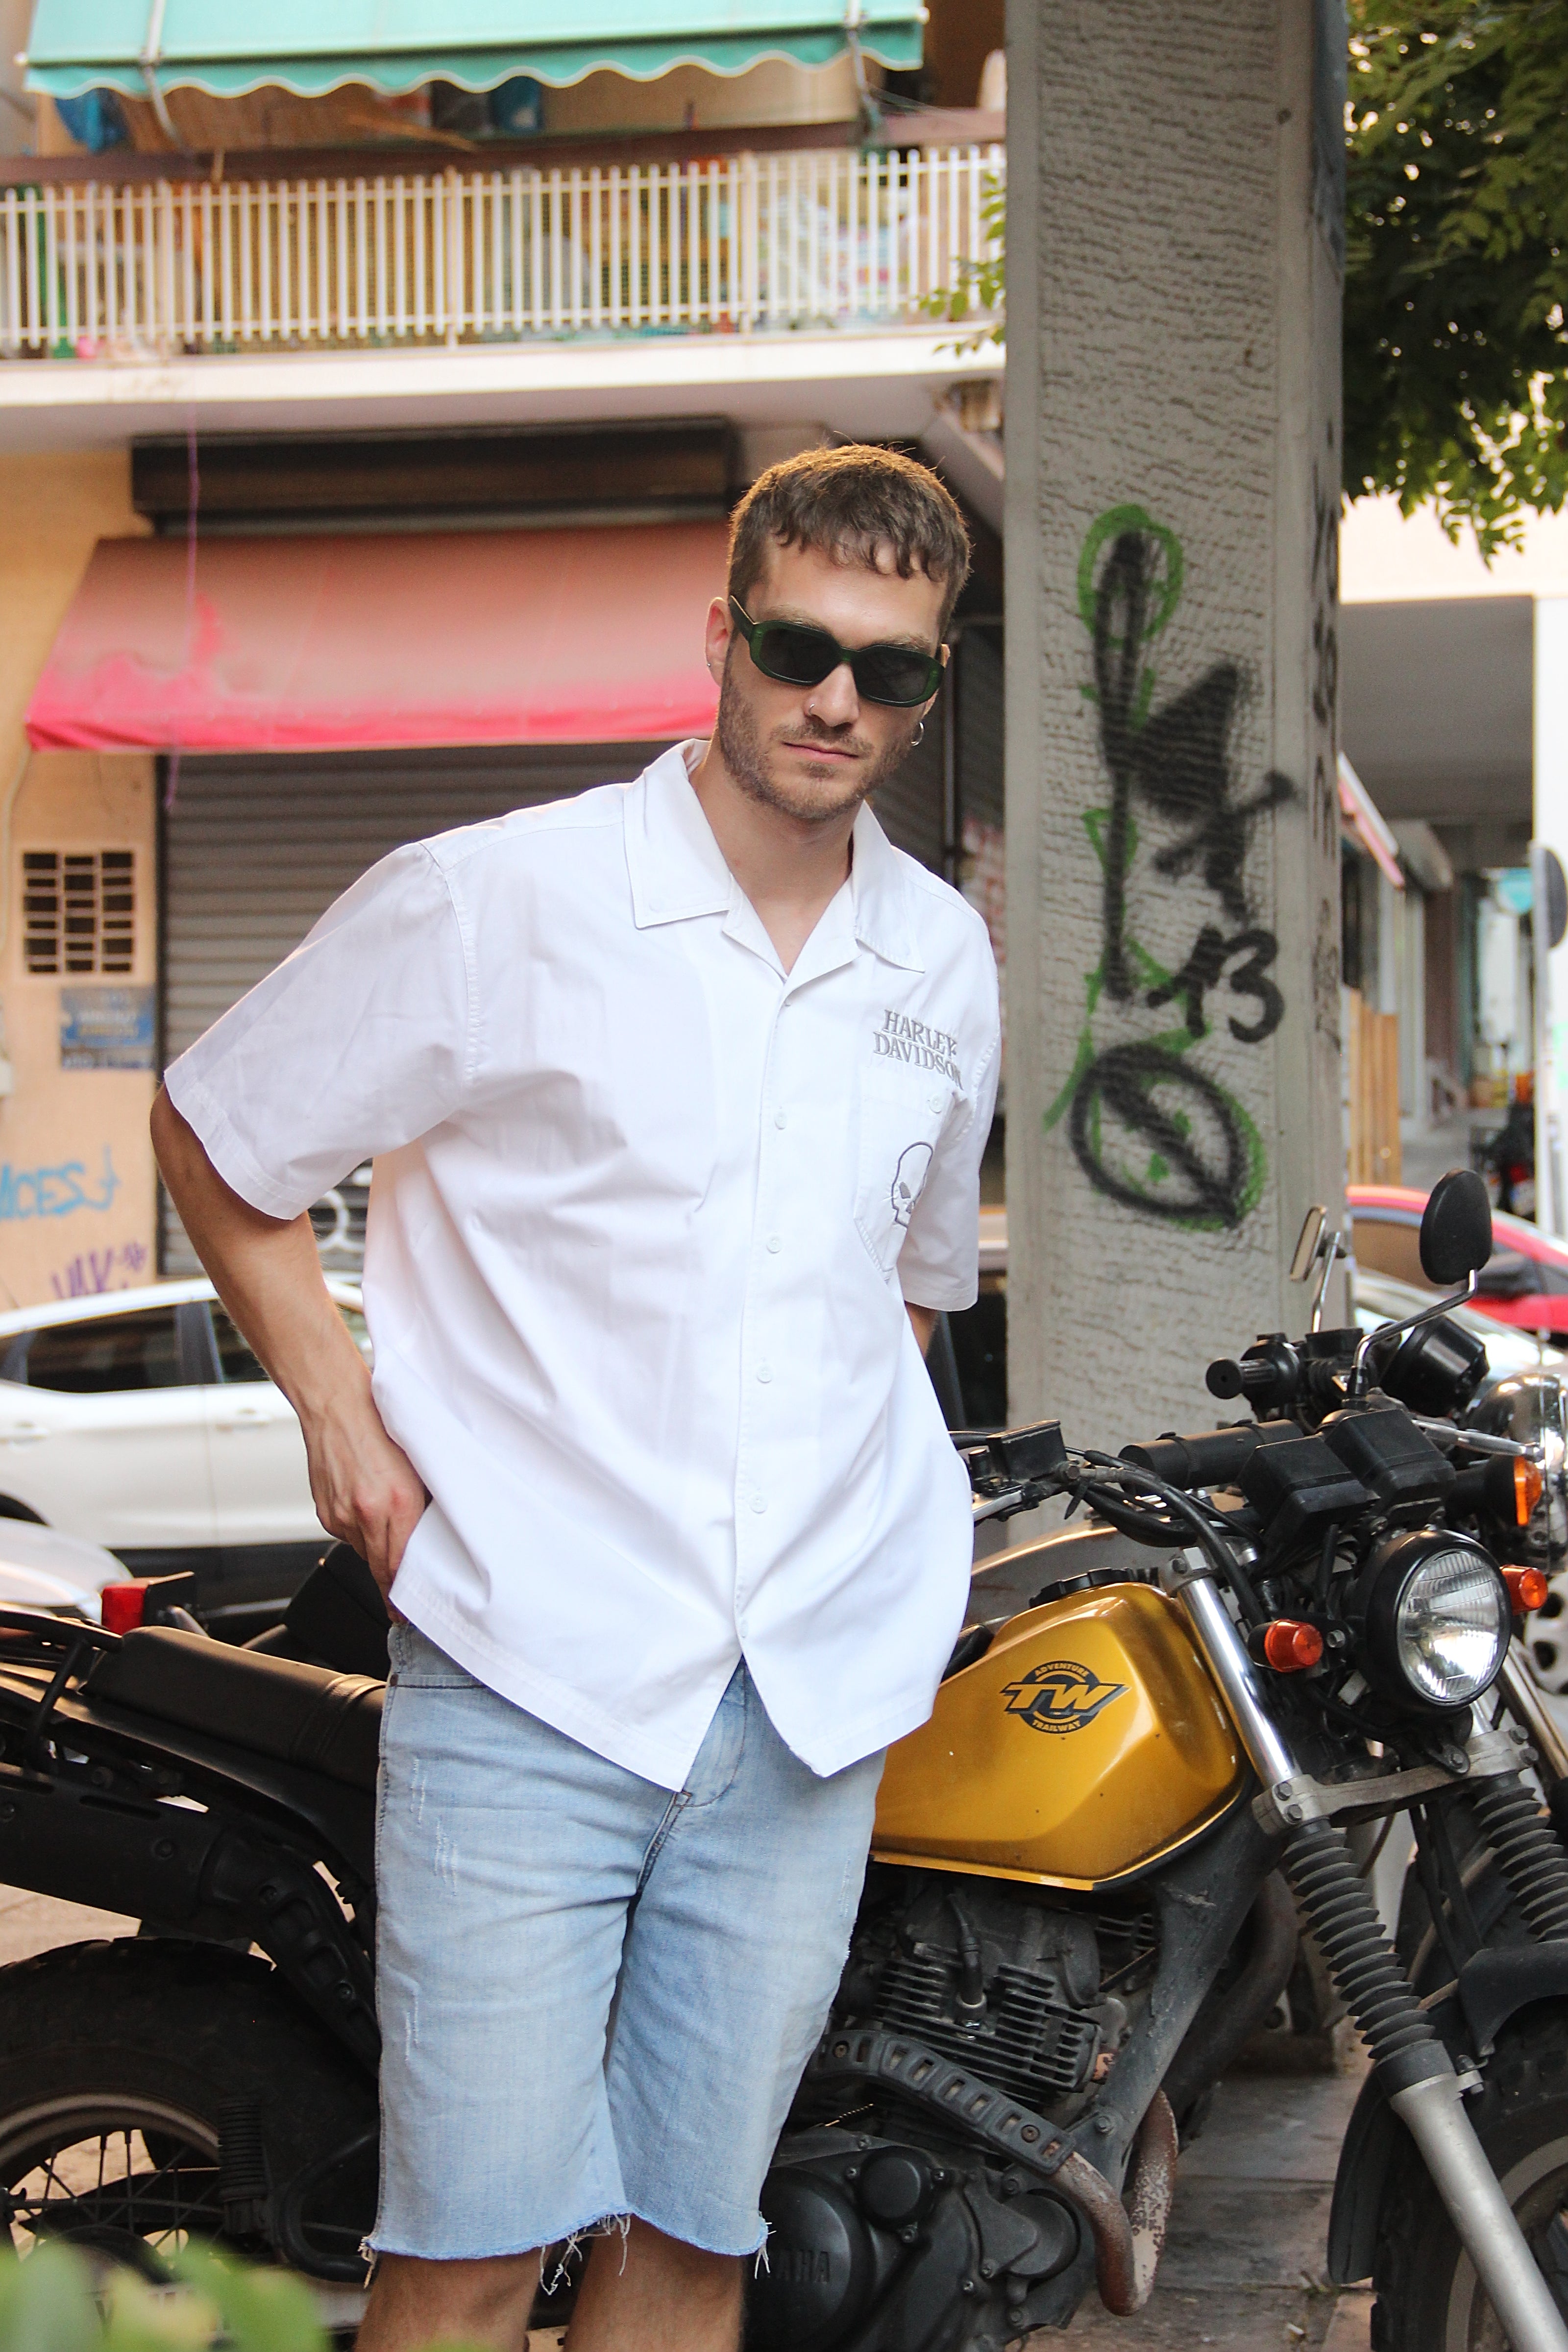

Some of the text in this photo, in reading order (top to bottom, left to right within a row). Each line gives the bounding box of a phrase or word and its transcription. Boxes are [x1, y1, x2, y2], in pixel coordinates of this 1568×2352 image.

[1034, 1663, 1090, 1677] ADVENTURE
[1002, 1683, 1122, 1711] TW
[1032, 1719, 1081, 1732] TRAILWAY
